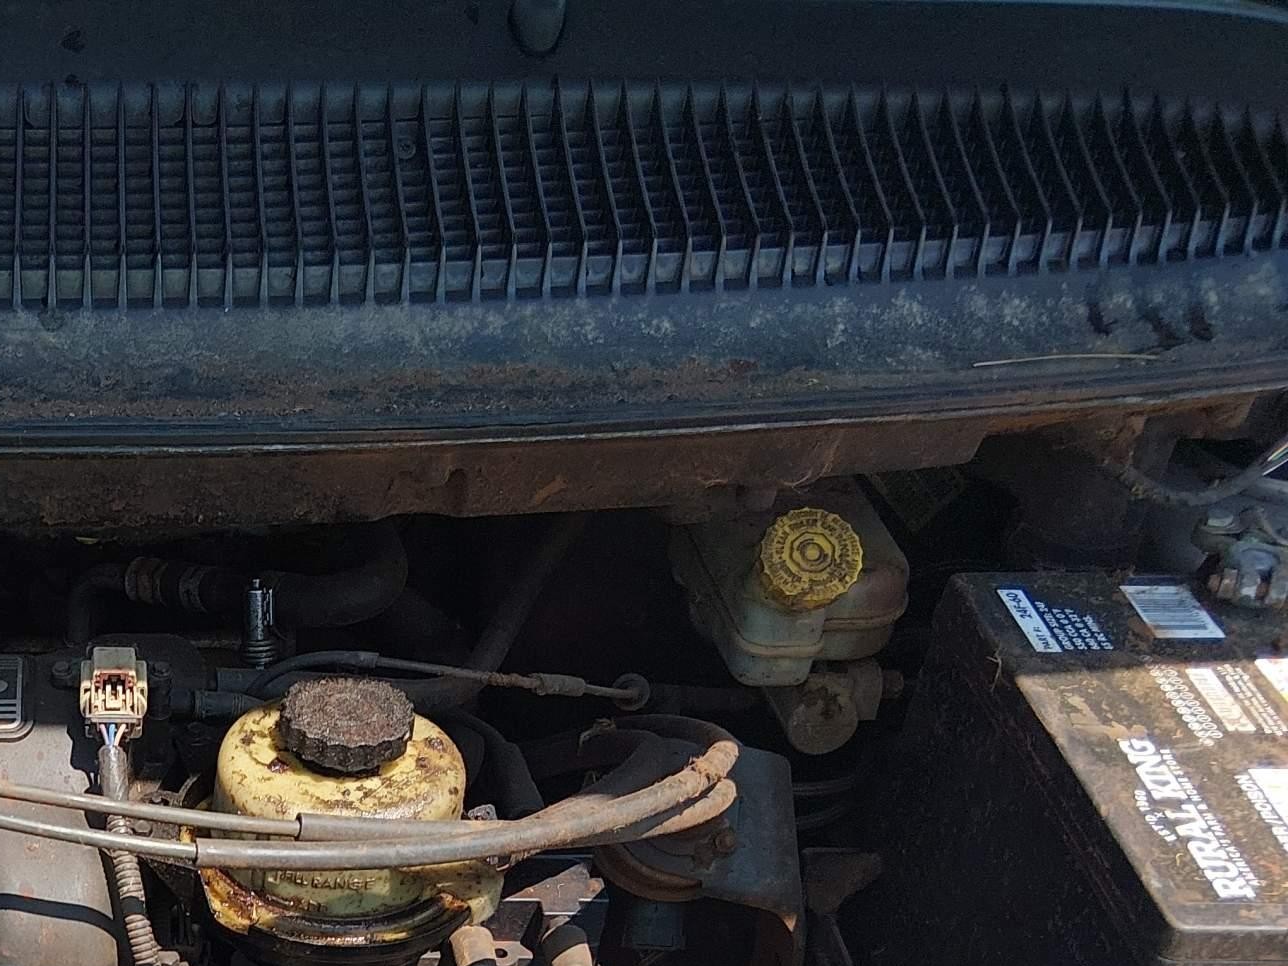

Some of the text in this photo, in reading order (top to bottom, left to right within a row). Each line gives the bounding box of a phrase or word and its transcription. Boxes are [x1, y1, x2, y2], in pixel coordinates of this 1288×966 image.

[1117, 738, 1189, 800] KING
[1178, 777, 1203, 802] HOME
[1202, 812, 1226, 837] FARM
[1164, 804, 1257, 899] RURAL
[312, 876, 376, 890] RANGE
